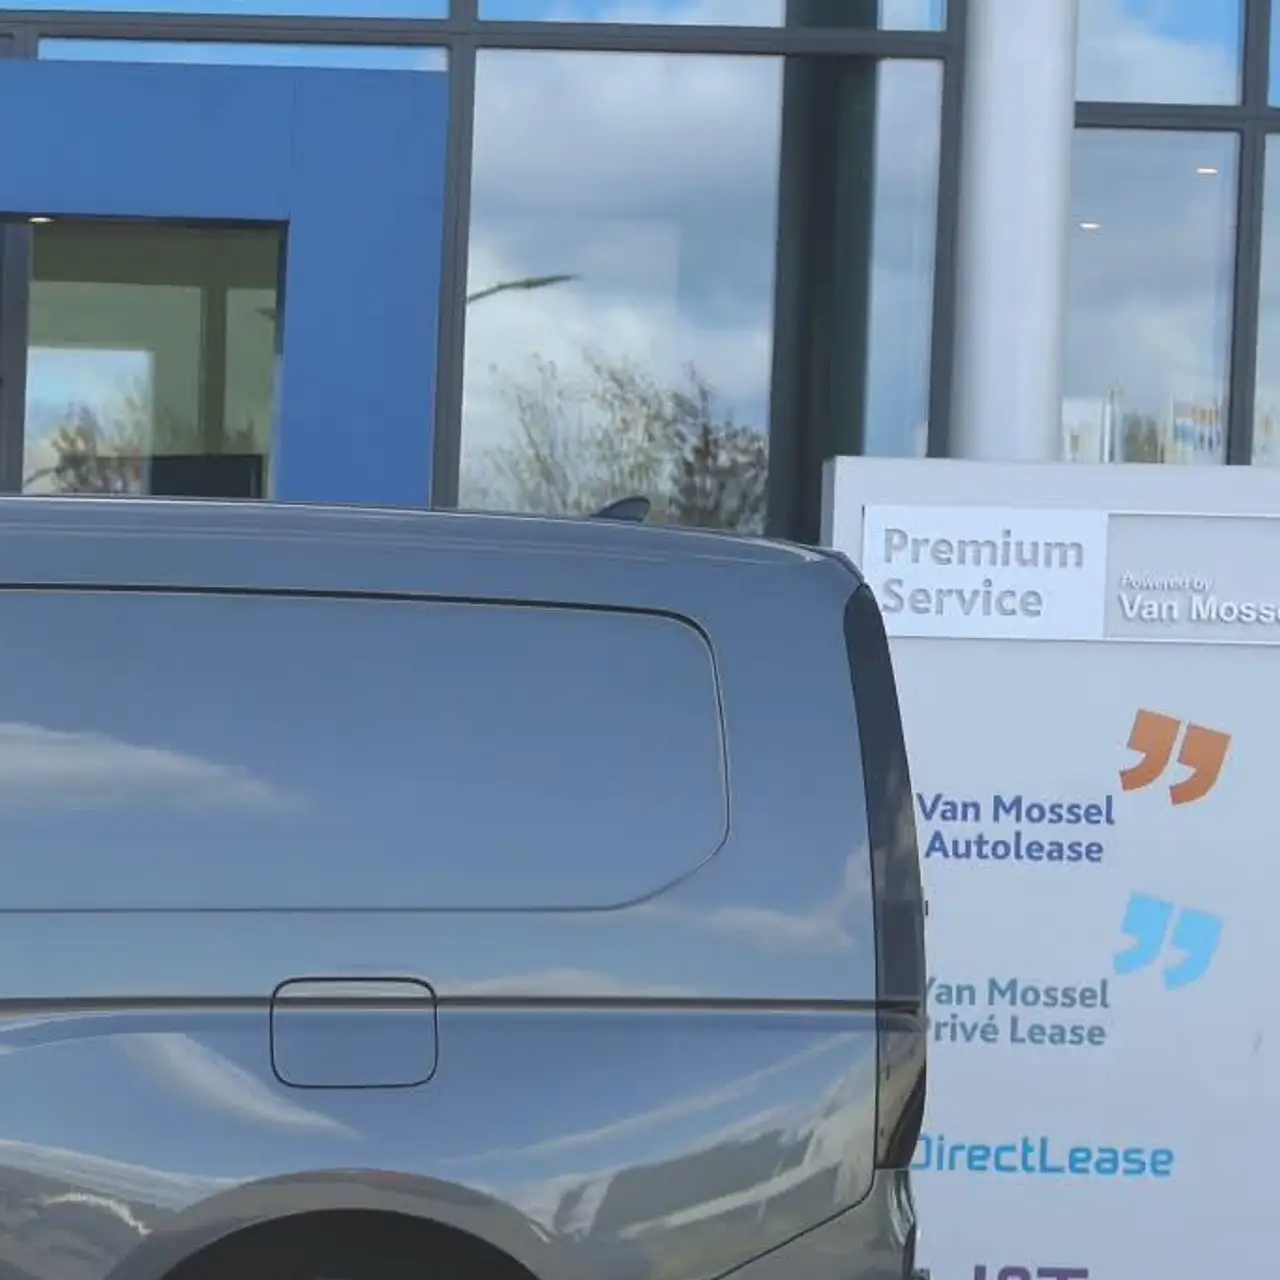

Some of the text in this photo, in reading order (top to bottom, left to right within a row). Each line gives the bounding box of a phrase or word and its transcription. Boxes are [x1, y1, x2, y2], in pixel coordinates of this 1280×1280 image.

[883, 528, 1085, 570] Premium
[881, 578, 1044, 618] Service
[1119, 592, 1179, 621] Van
[916, 793, 1116, 826] Van Mossel
[925, 830, 1105, 863] Autolease
[988, 977, 1111, 1010] Mossel
[927, 1013, 1108, 1047] rivé Lease
